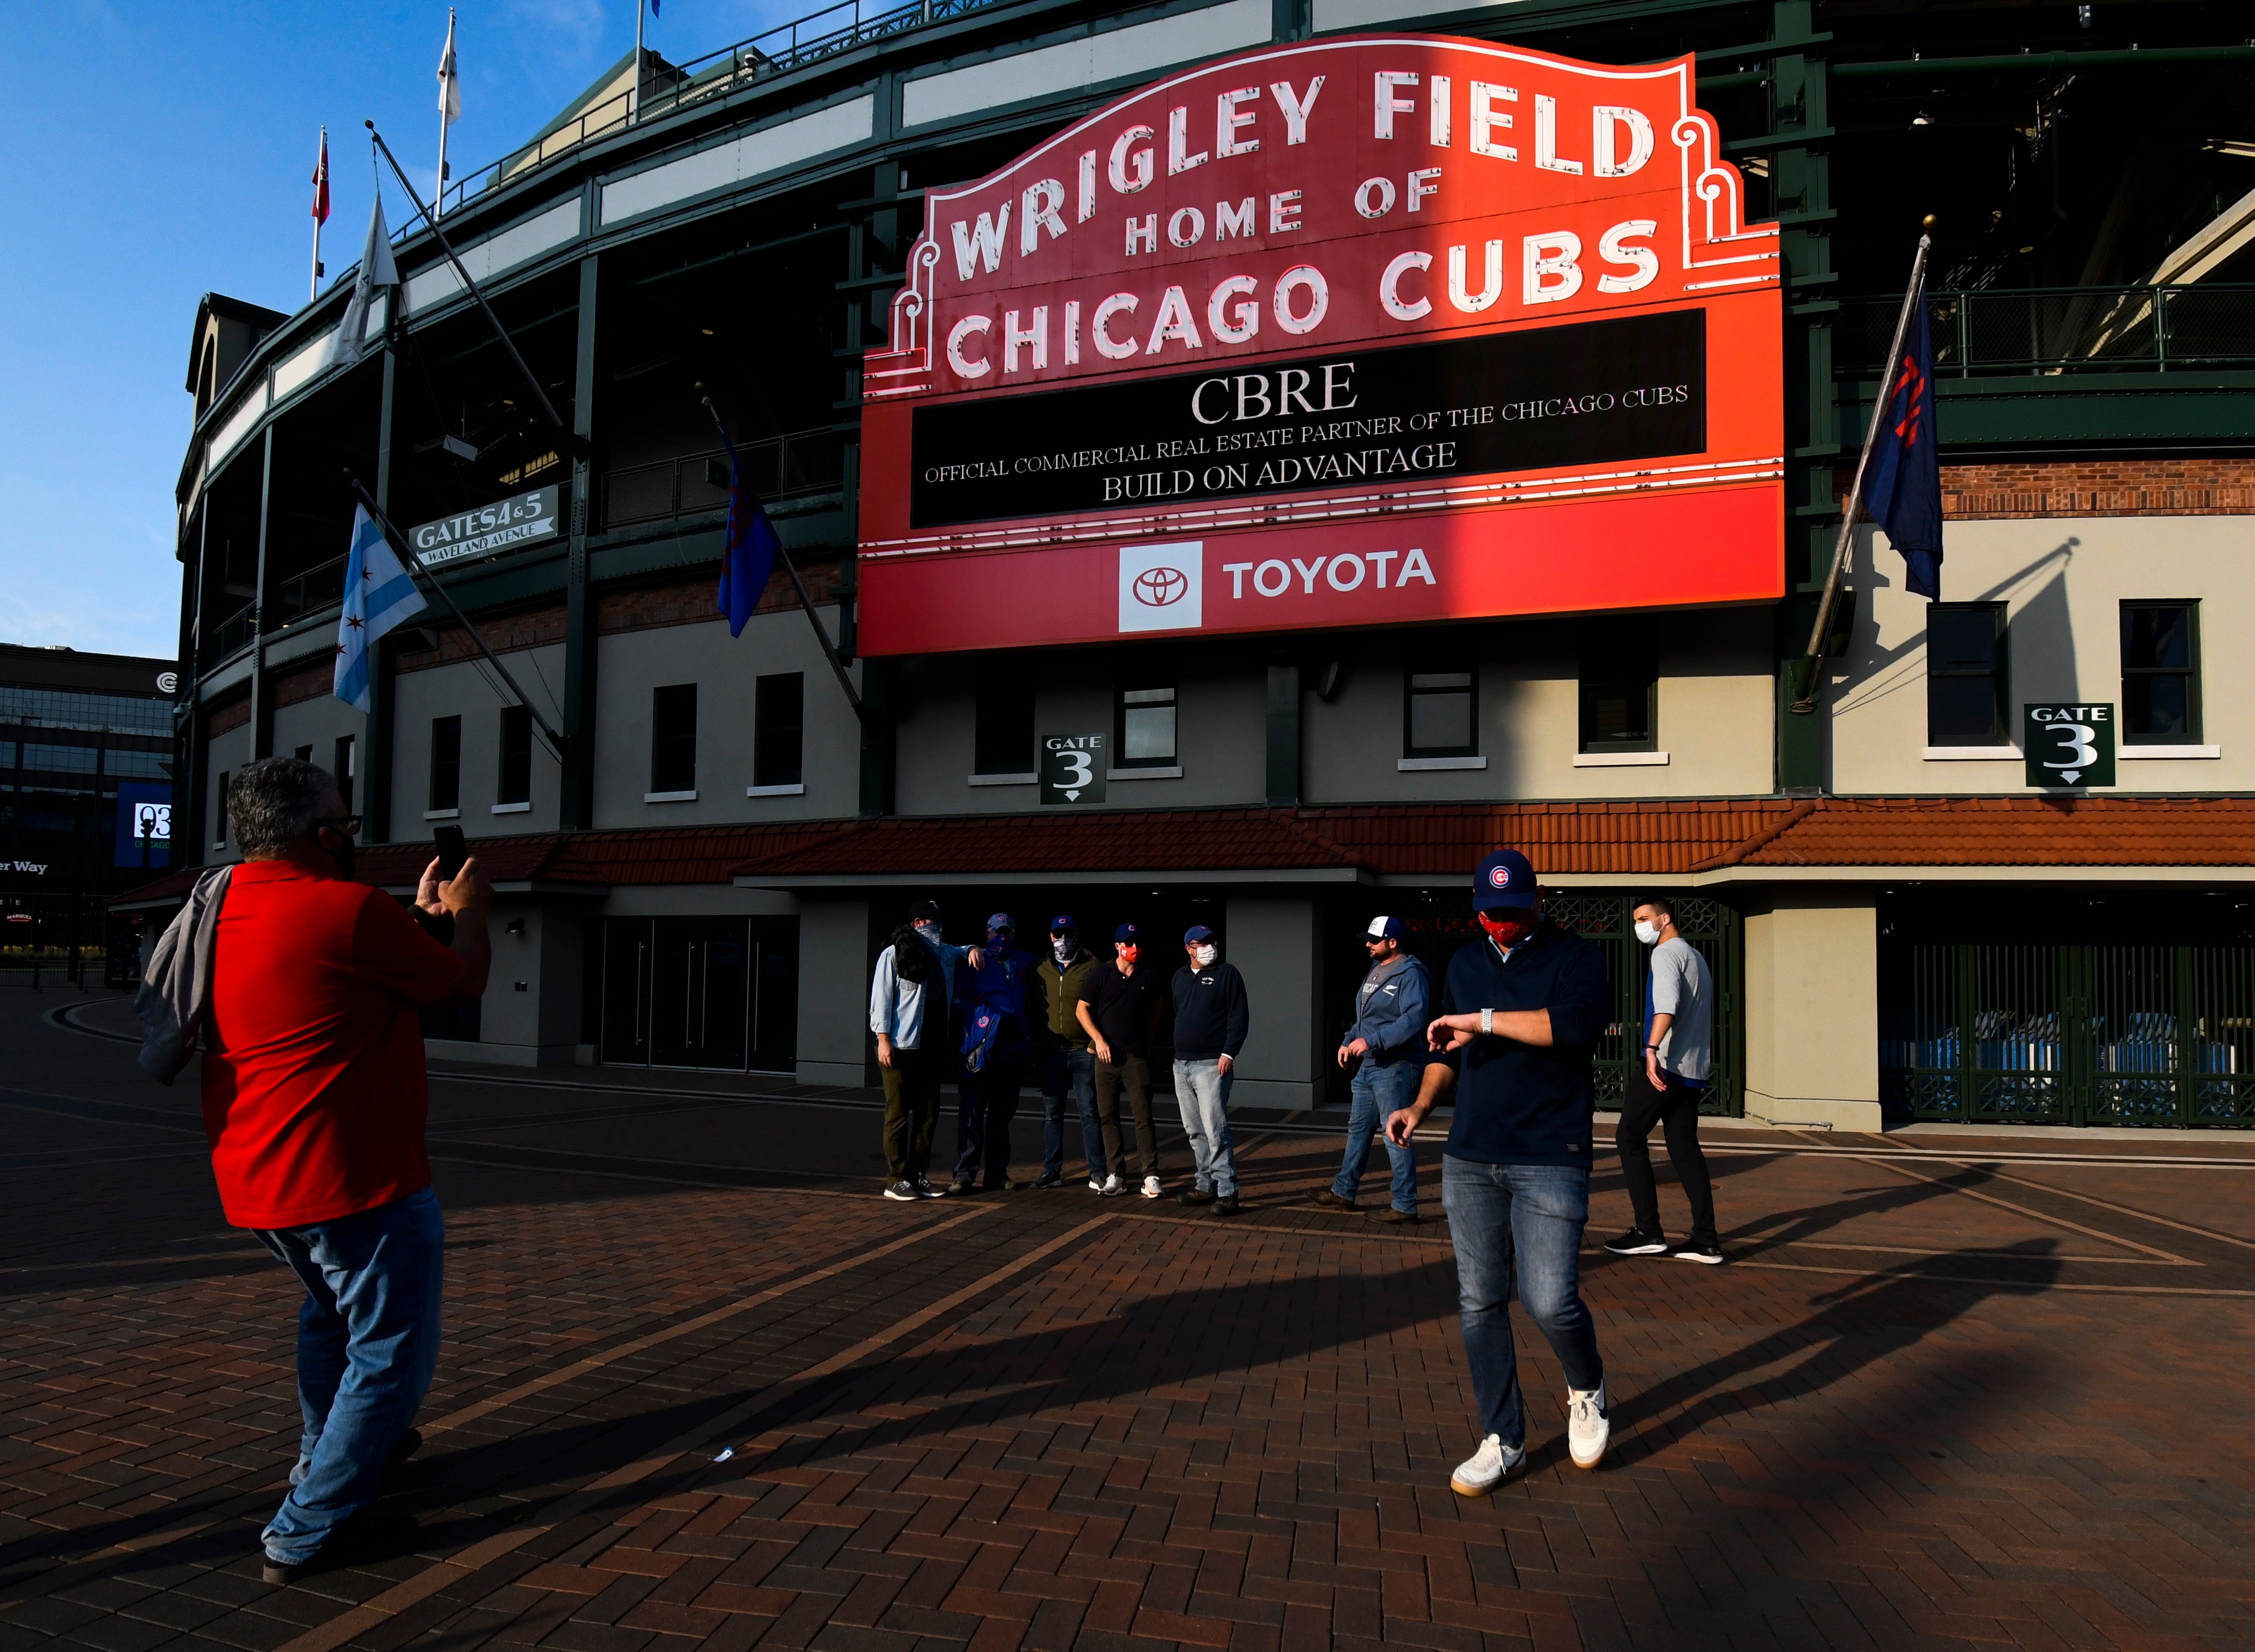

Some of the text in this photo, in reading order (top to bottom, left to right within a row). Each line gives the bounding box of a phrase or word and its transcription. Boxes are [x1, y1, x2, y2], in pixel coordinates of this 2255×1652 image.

[951, 71, 1654, 282] WRIGLEY FIELD
[1125, 167, 1442, 256] HOME OF
[946, 219, 1659, 379] CHICAGO CUBS
[1191, 362, 1358, 425] CBRE
[925, 384, 1688, 483] OFFICIAL COMMERCIAL REAL ESTATE PARTNER OF THE CHICAGO CUBS
[1102, 442, 1457, 501] BUILD ON ADVANTAGE
[417, 508, 495, 548] GATES
[428, 523, 536, 562] WAVELAND AVENUE
[1223, 548, 1437, 599] TOYOTA
[2031, 706, 2108, 722] GATE
[1046, 736, 1102, 750] GATE
[2042, 723, 2098, 769] 3
[1052, 751, 1093, 789] 3
[13, 861, 48, 875] Way
